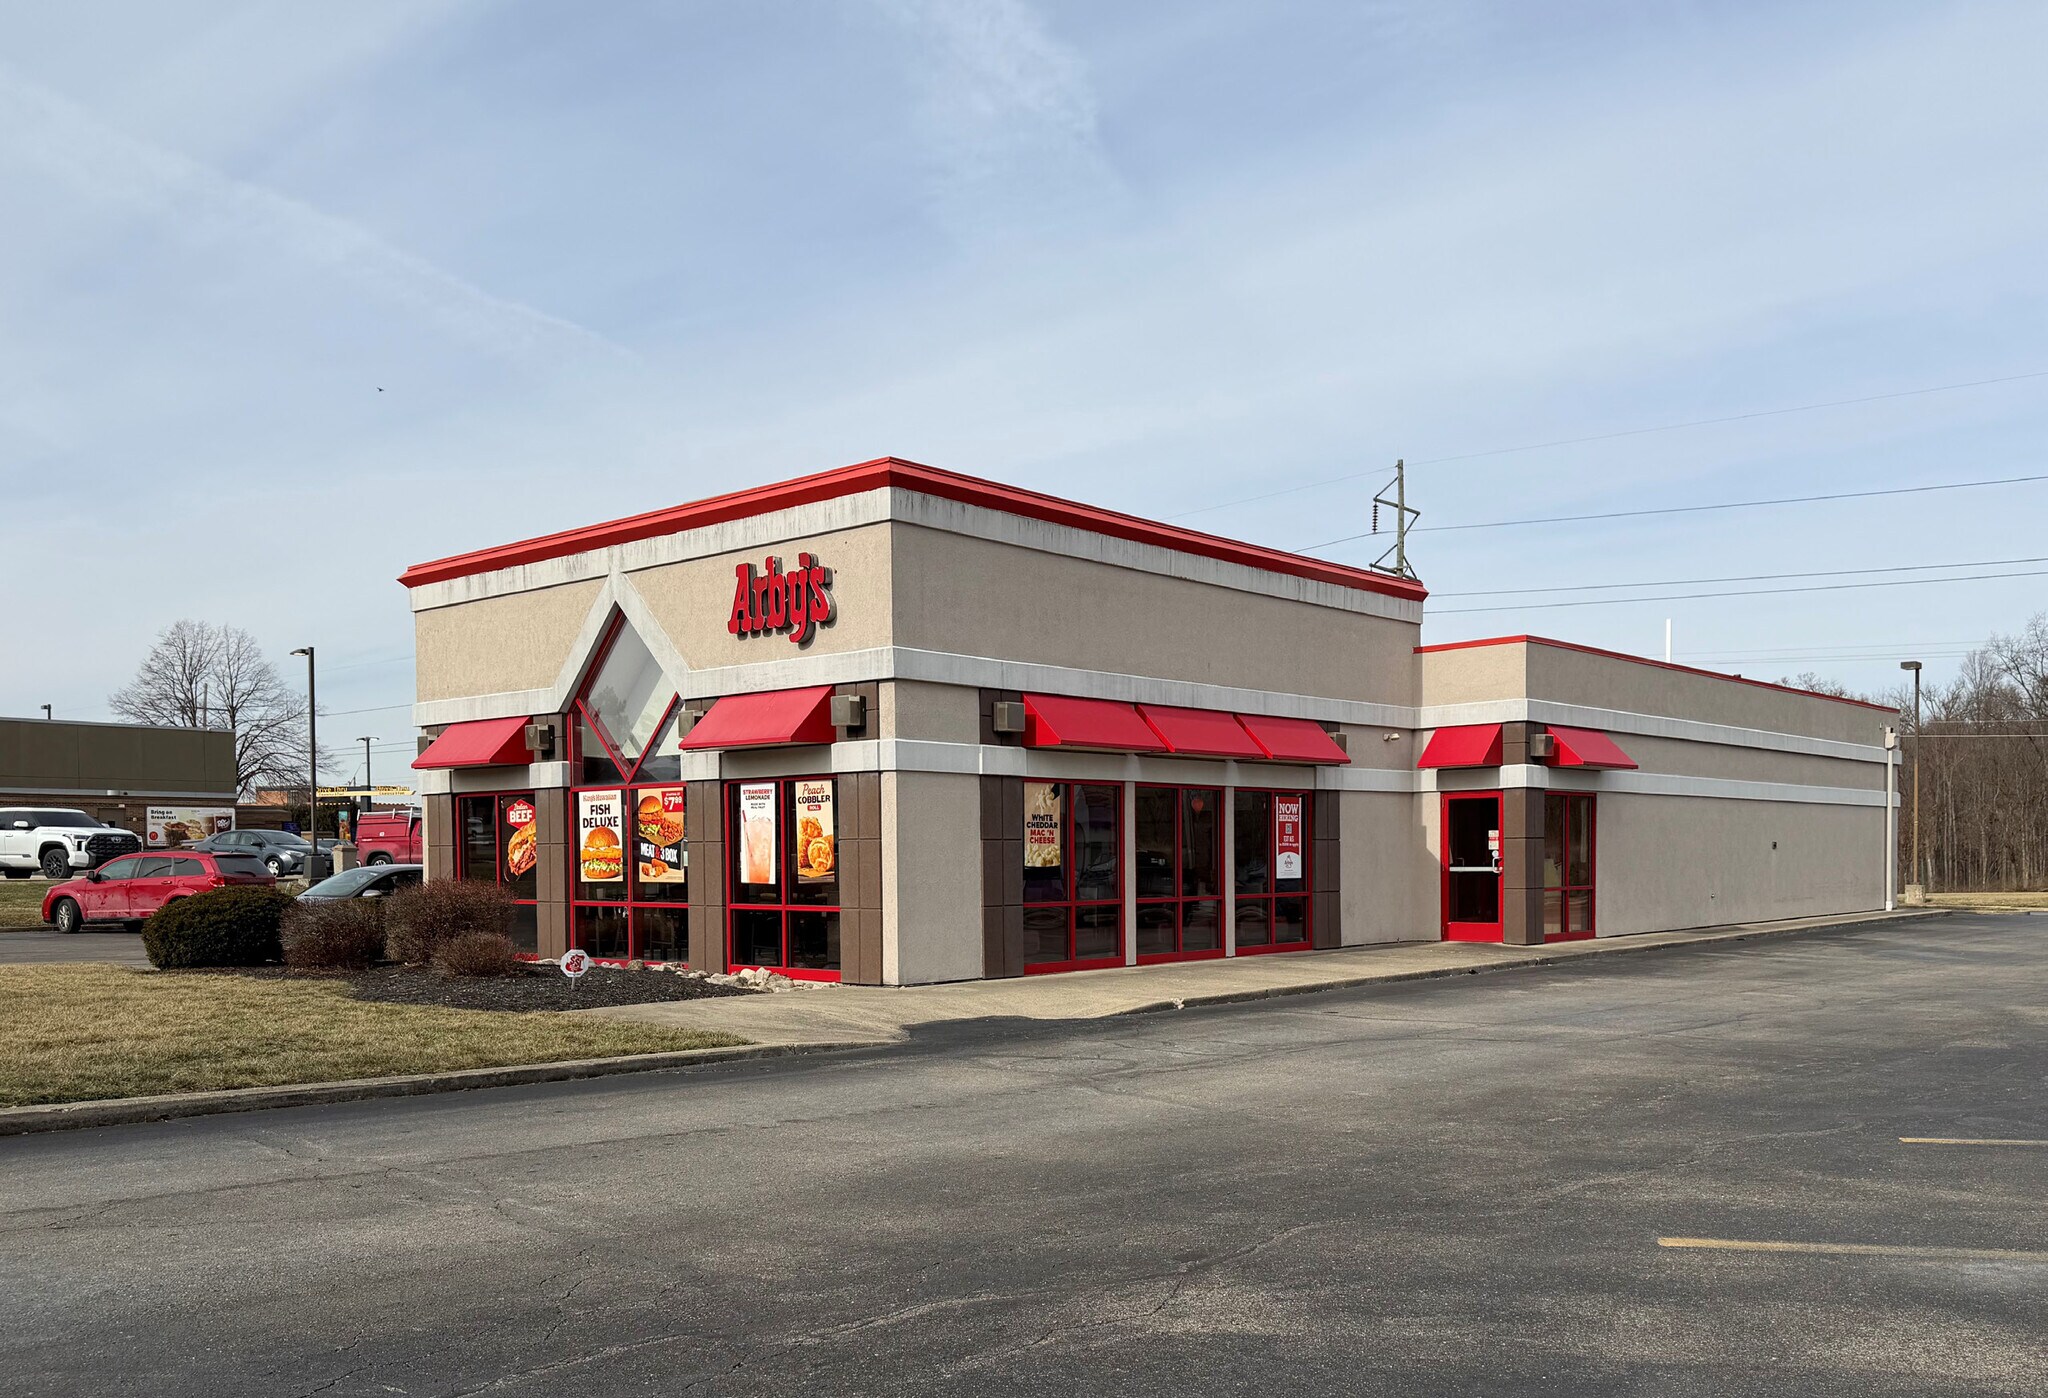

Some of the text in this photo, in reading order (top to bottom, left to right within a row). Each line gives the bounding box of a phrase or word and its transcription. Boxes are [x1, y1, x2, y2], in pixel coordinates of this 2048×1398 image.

[728, 552, 833, 644] Arby's
[802, 783, 825, 796] Peach
[797, 795, 831, 804] COBBLER
[590, 804, 611, 815] FISH
[1279, 803, 1299, 814] NOW
[509, 810, 533, 822] BEEF
[583, 816, 619, 828] DELUXE
[640, 842, 678, 863] MEAT & 3 BOX
